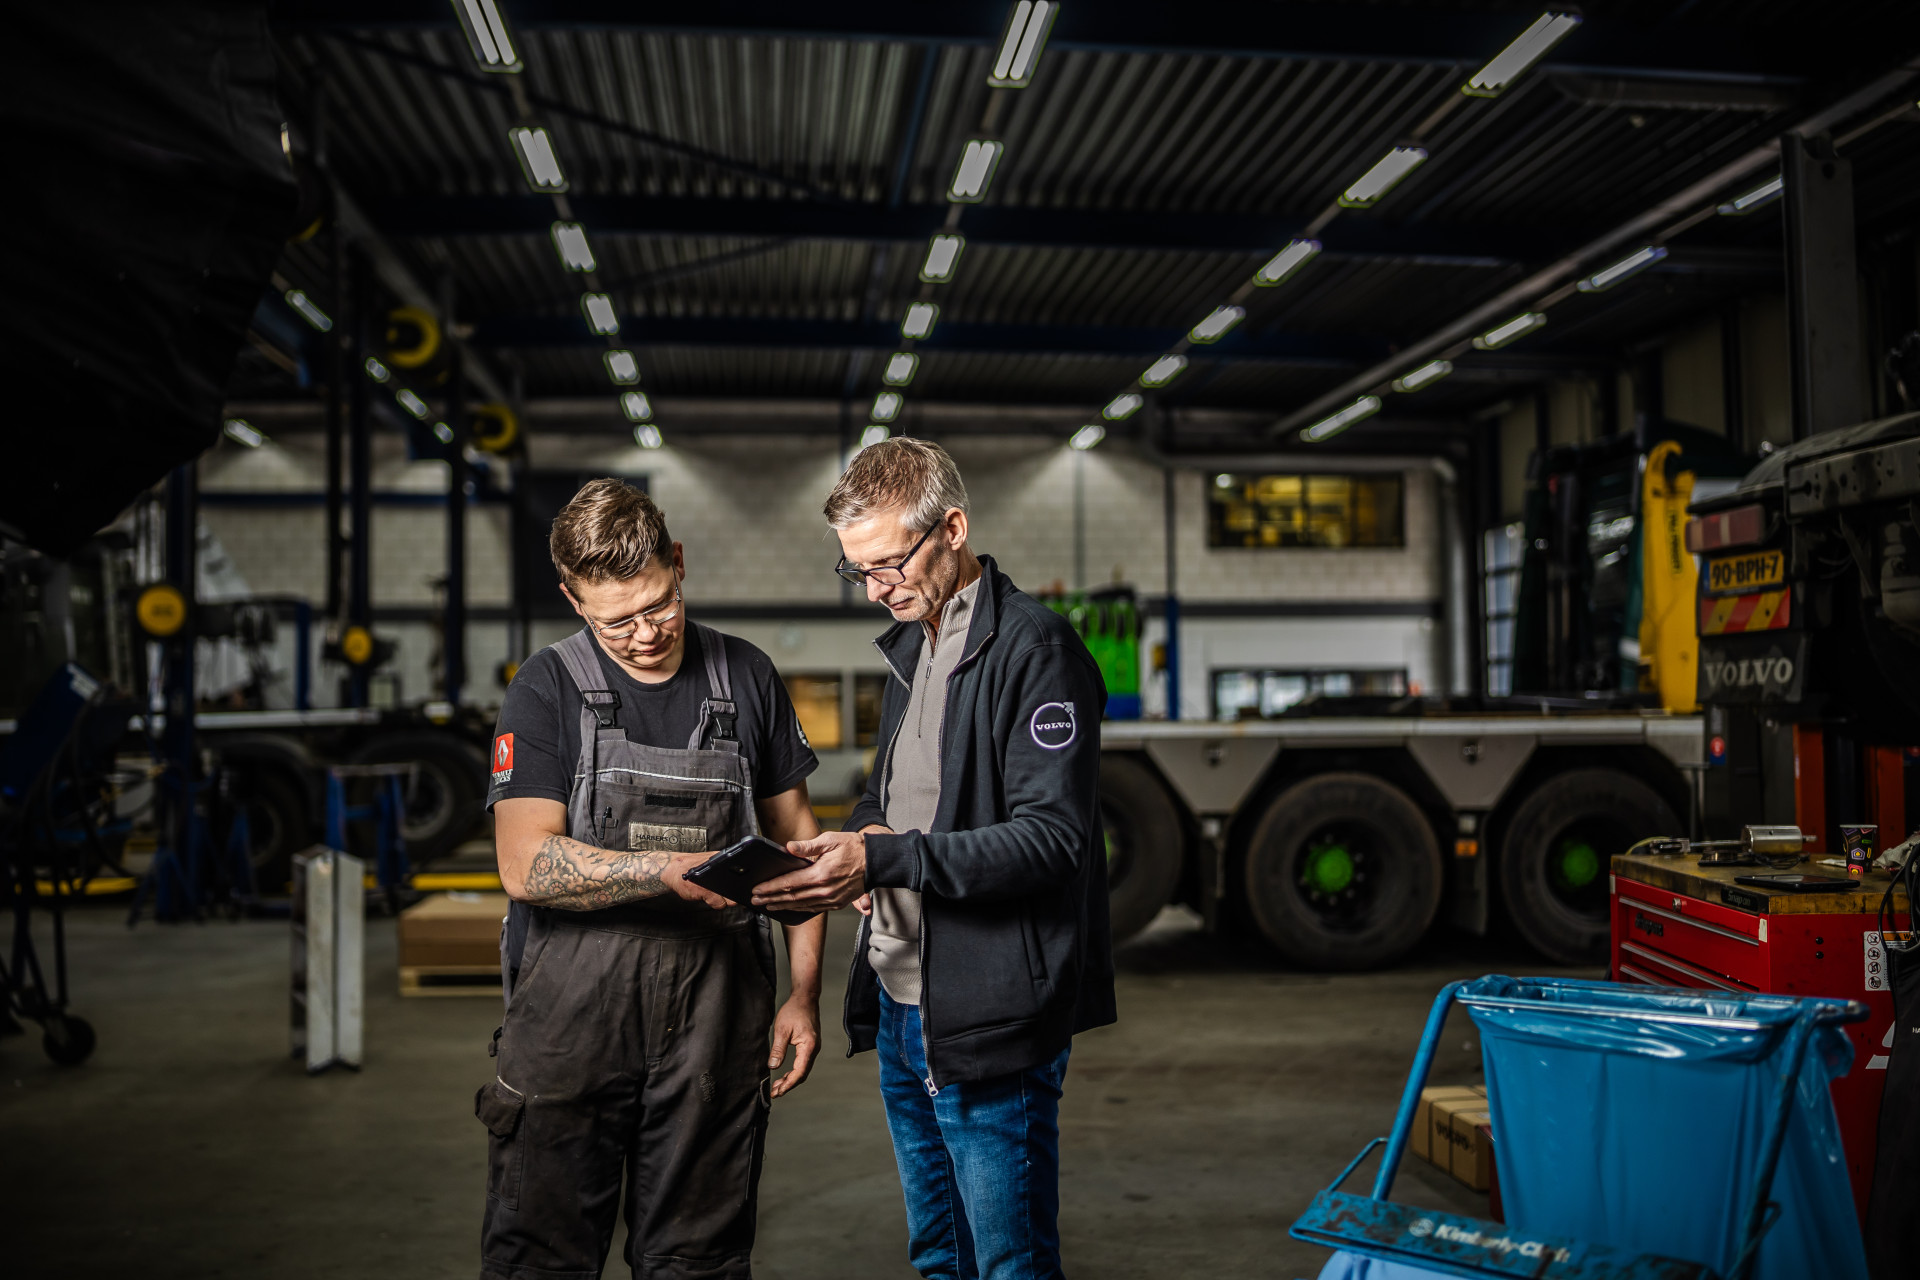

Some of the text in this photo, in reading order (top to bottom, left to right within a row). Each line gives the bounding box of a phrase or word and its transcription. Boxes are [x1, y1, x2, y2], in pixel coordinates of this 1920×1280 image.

[1712, 555, 1779, 587] 90-BPH-7
[1705, 656, 1793, 688] VOLVO
[1035, 721, 1071, 731] VOLVO
